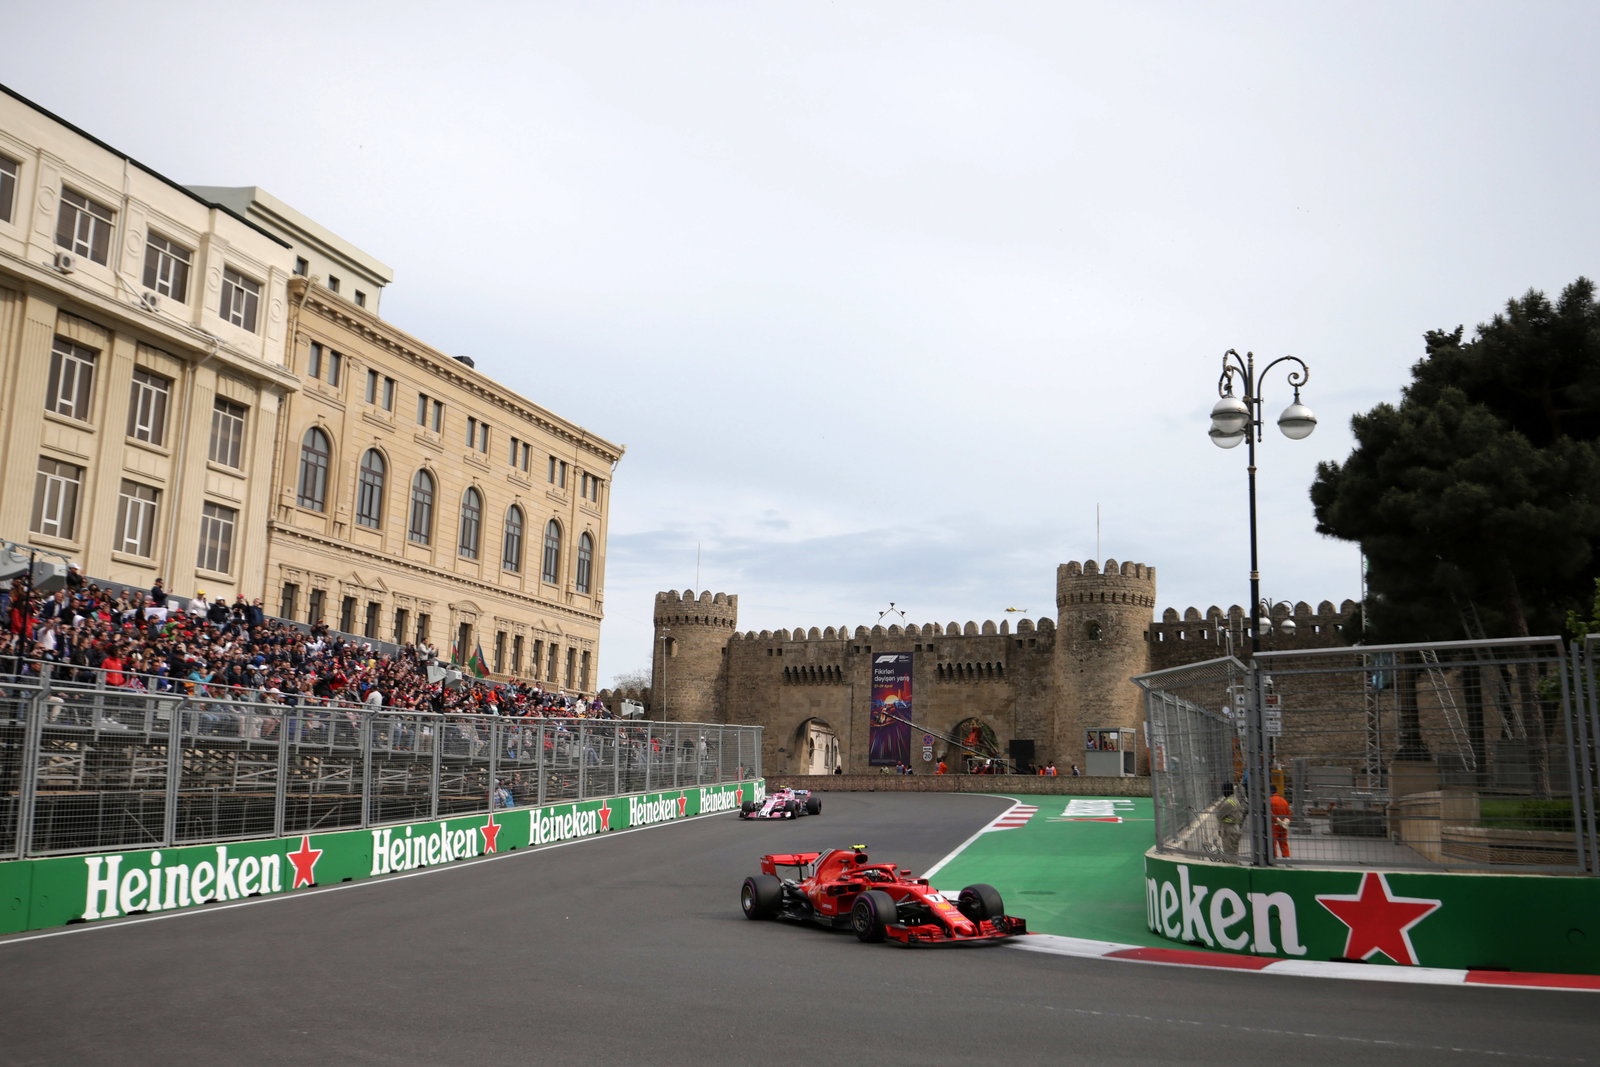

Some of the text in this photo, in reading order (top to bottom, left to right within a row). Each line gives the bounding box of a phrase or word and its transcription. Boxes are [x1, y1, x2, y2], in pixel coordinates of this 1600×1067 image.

[629, 794, 677, 827] Heineken
[700, 787, 736, 814] Heineken
[529, 805, 597, 845] Heineken
[370, 822, 479, 876] Heineken
[81, 846, 282, 920] Heineken
[929, 894, 940, 902] 7
